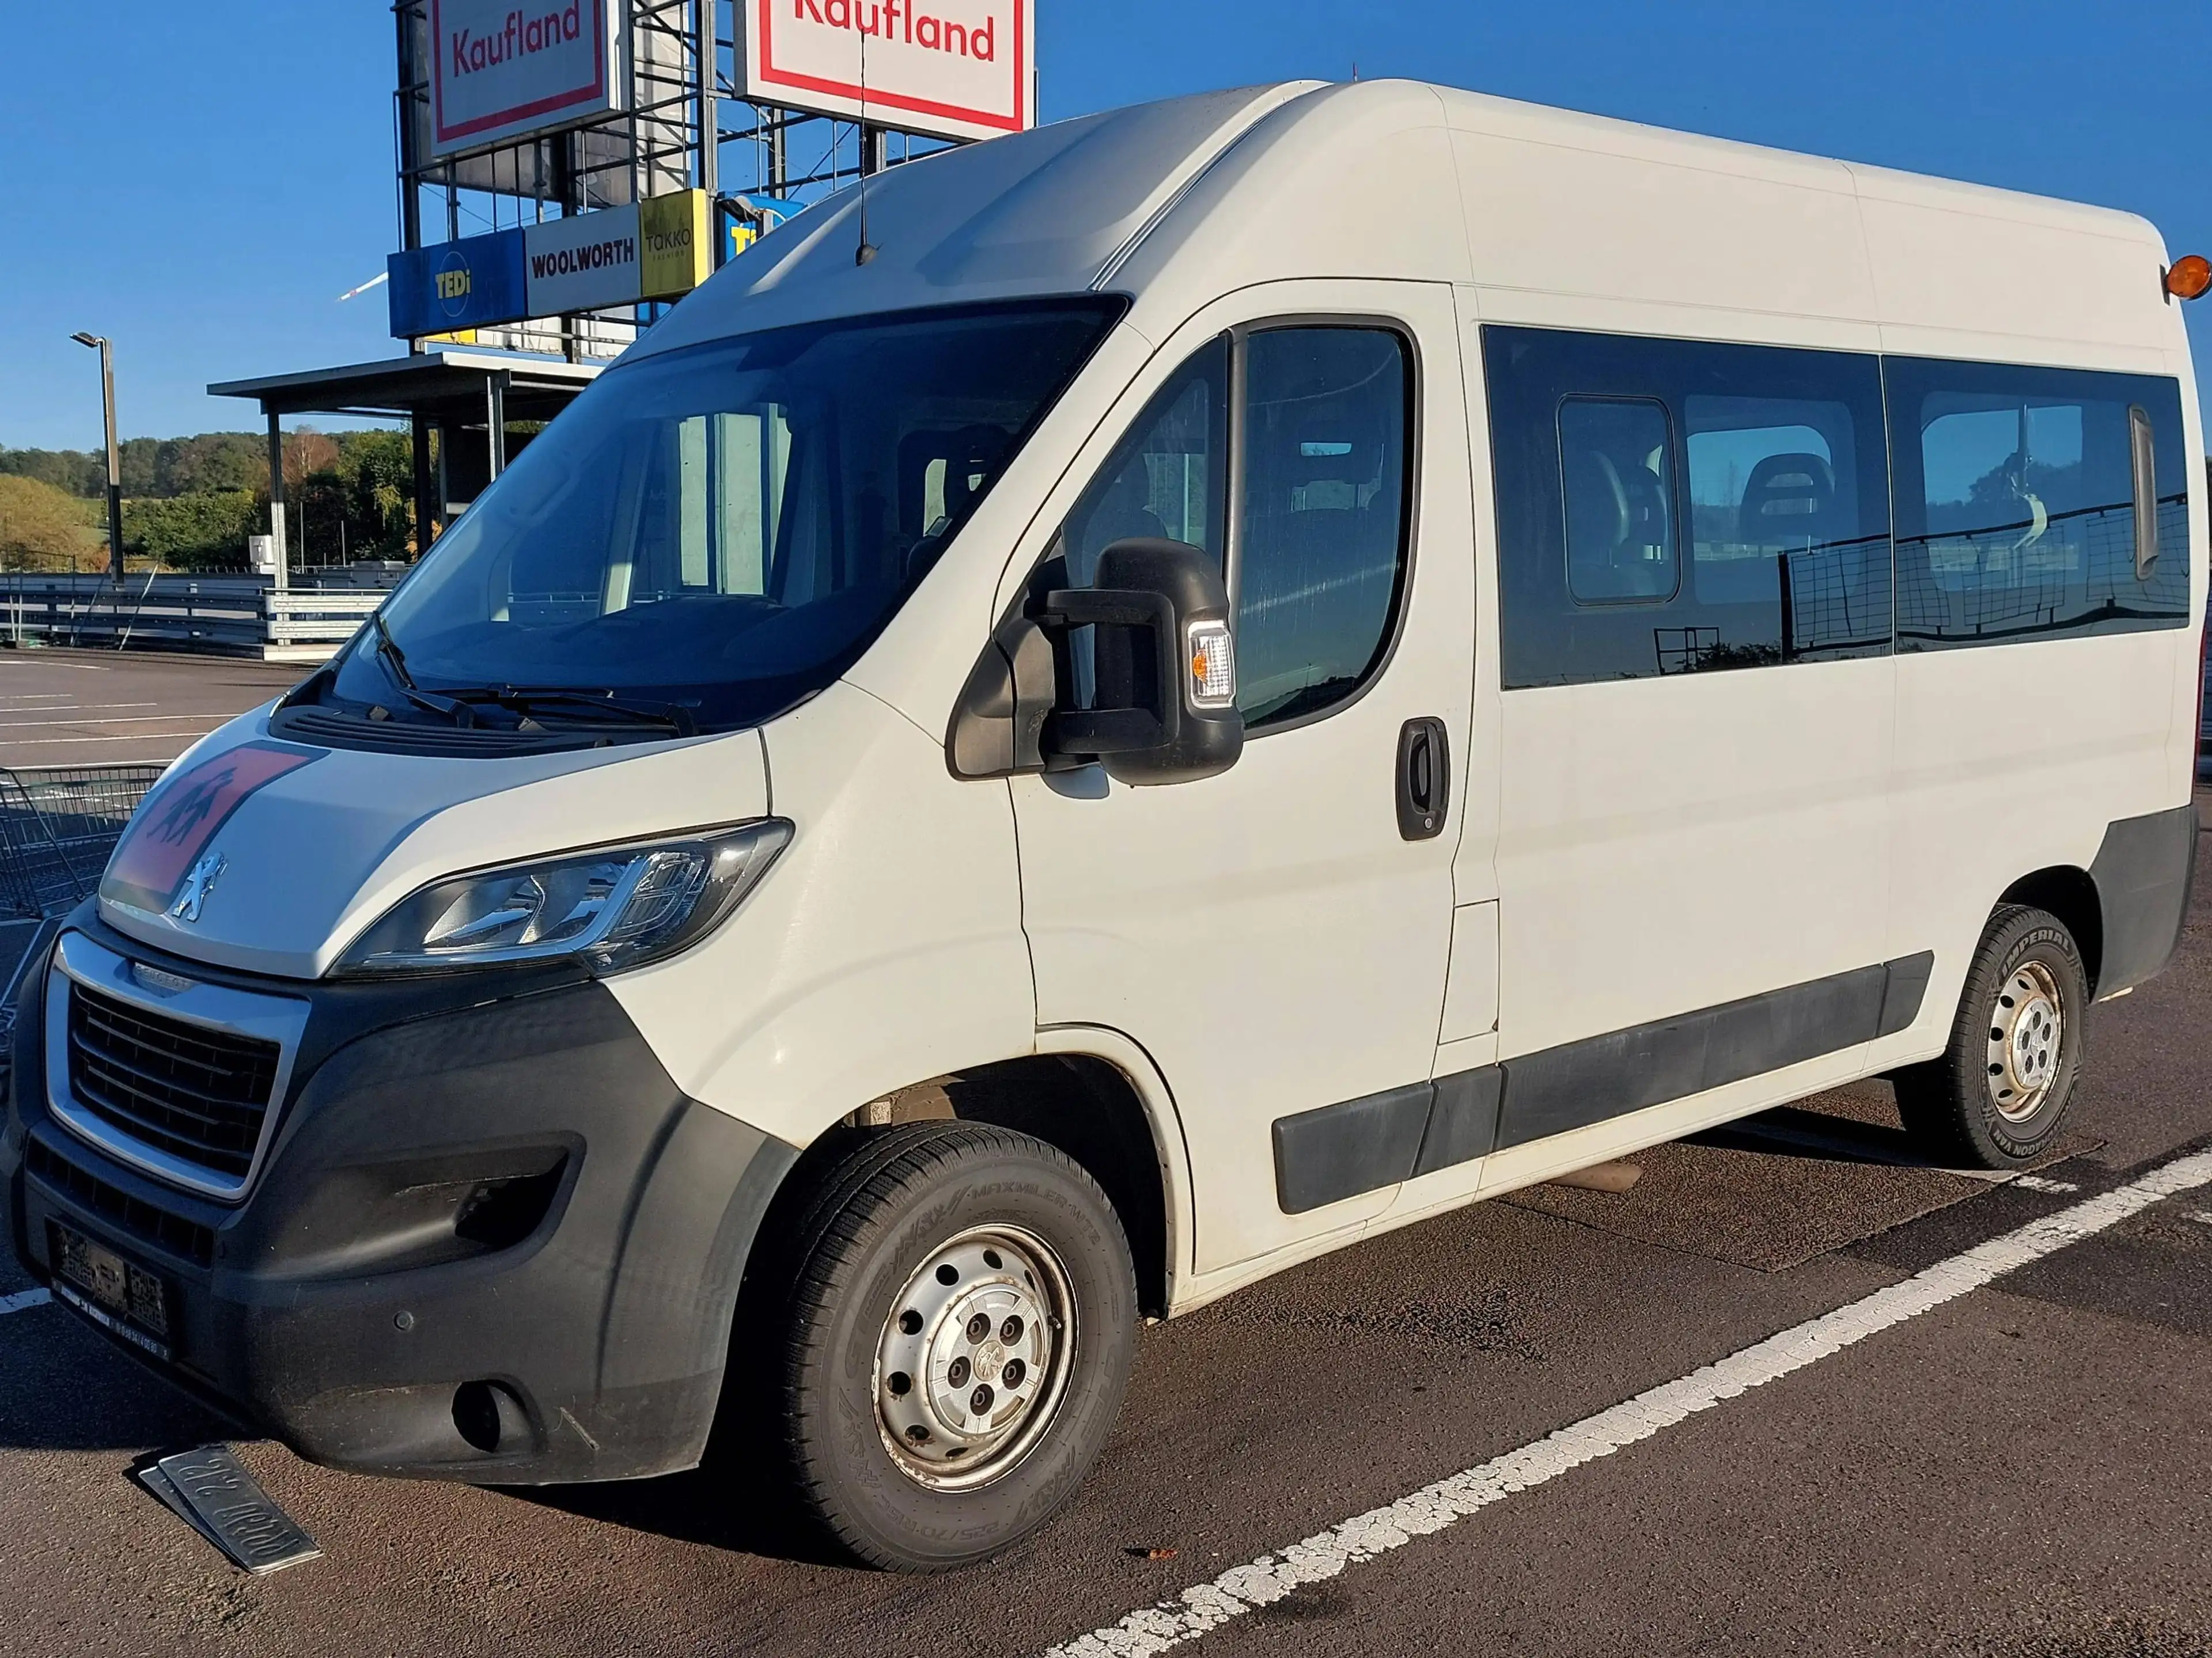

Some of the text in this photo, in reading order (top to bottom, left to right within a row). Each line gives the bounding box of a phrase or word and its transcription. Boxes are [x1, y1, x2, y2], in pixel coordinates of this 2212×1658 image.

[453, 0, 580, 78] Kaufland
[532, 237, 634, 279] WOOLWORTH
[435, 269, 470, 299] TEDi
[2002, 929, 2069, 977] IMPERIAL
[1993, 1128, 2012, 1152] VAN
[971, 1181, 1067, 1209] MAXMILER
